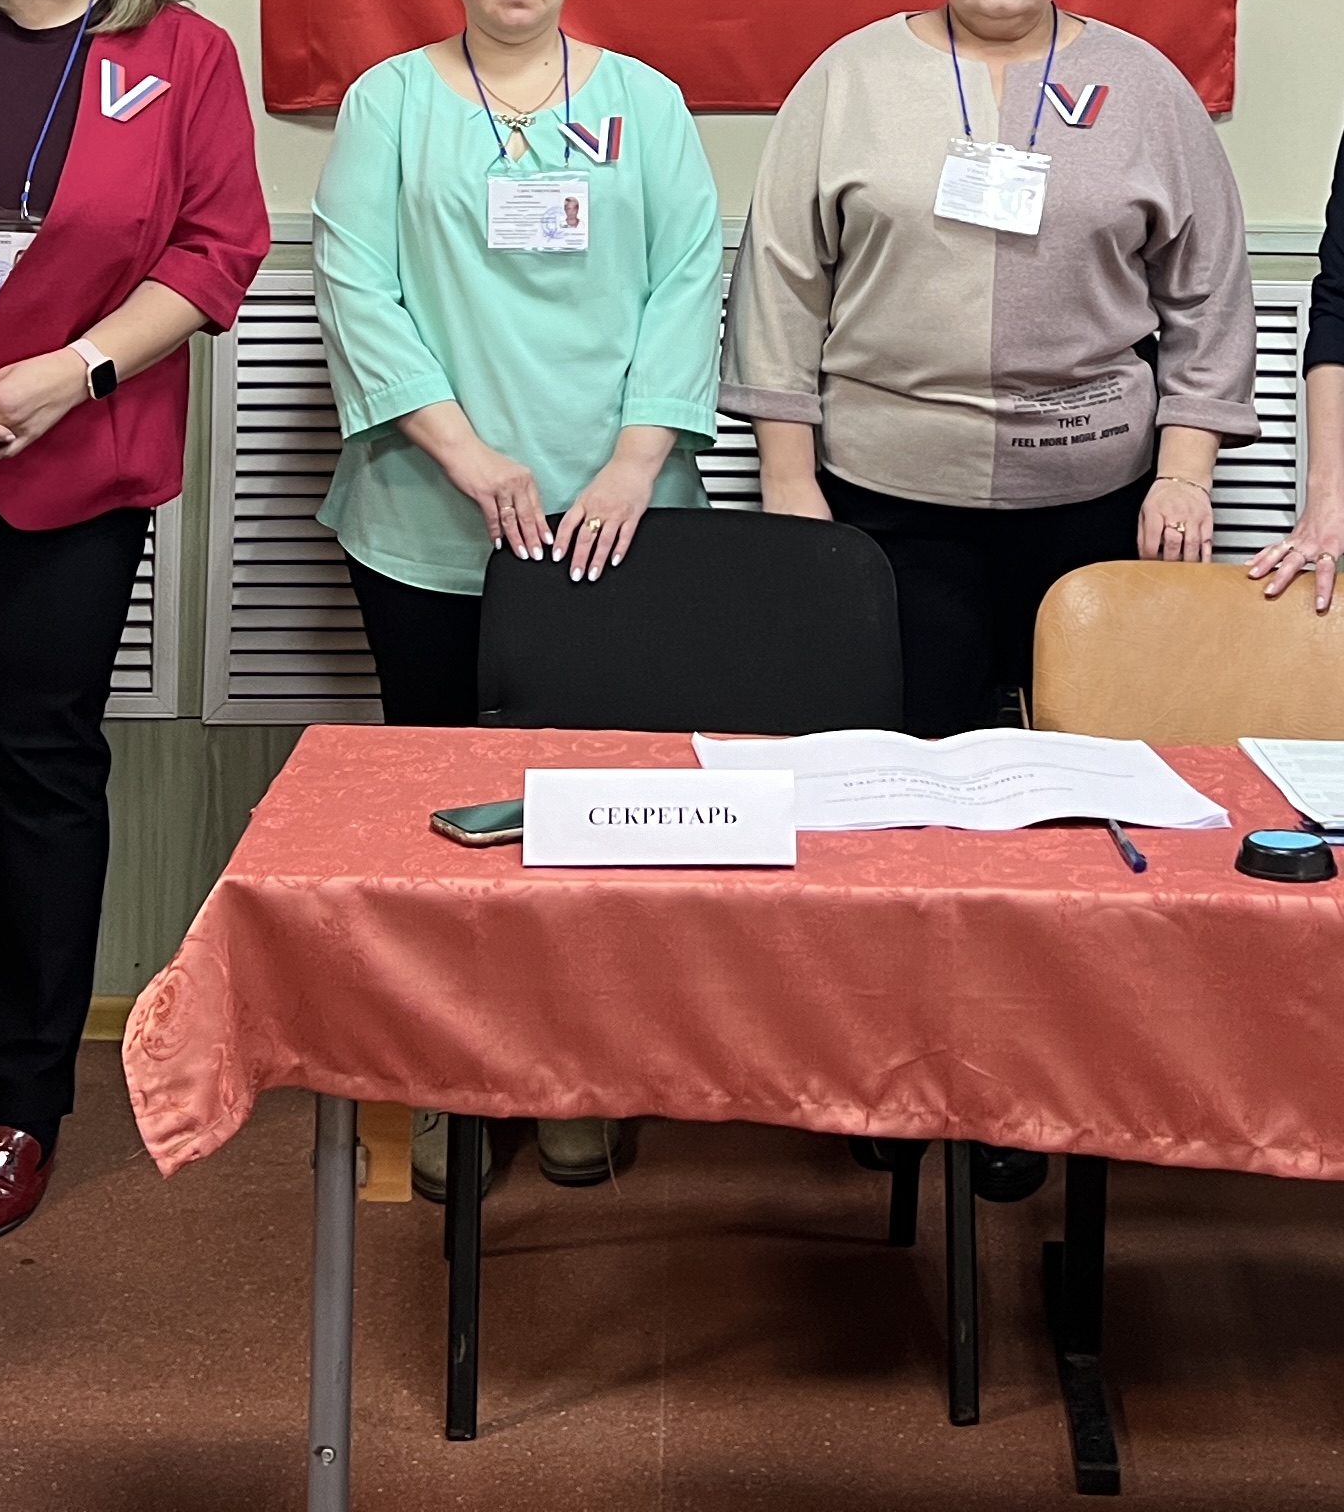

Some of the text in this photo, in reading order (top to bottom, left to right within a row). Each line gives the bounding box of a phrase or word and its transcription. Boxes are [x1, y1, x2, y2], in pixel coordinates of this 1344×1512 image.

[1057, 414, 1092, 429] THEY
[1011, 438, 1037, 448] FEEL
[1039, 437, 1068, 447] MORE
[1071, 431, 1097, 445] MORE
[588, 806, 738, 826] СЕКРЕТАРЬ
